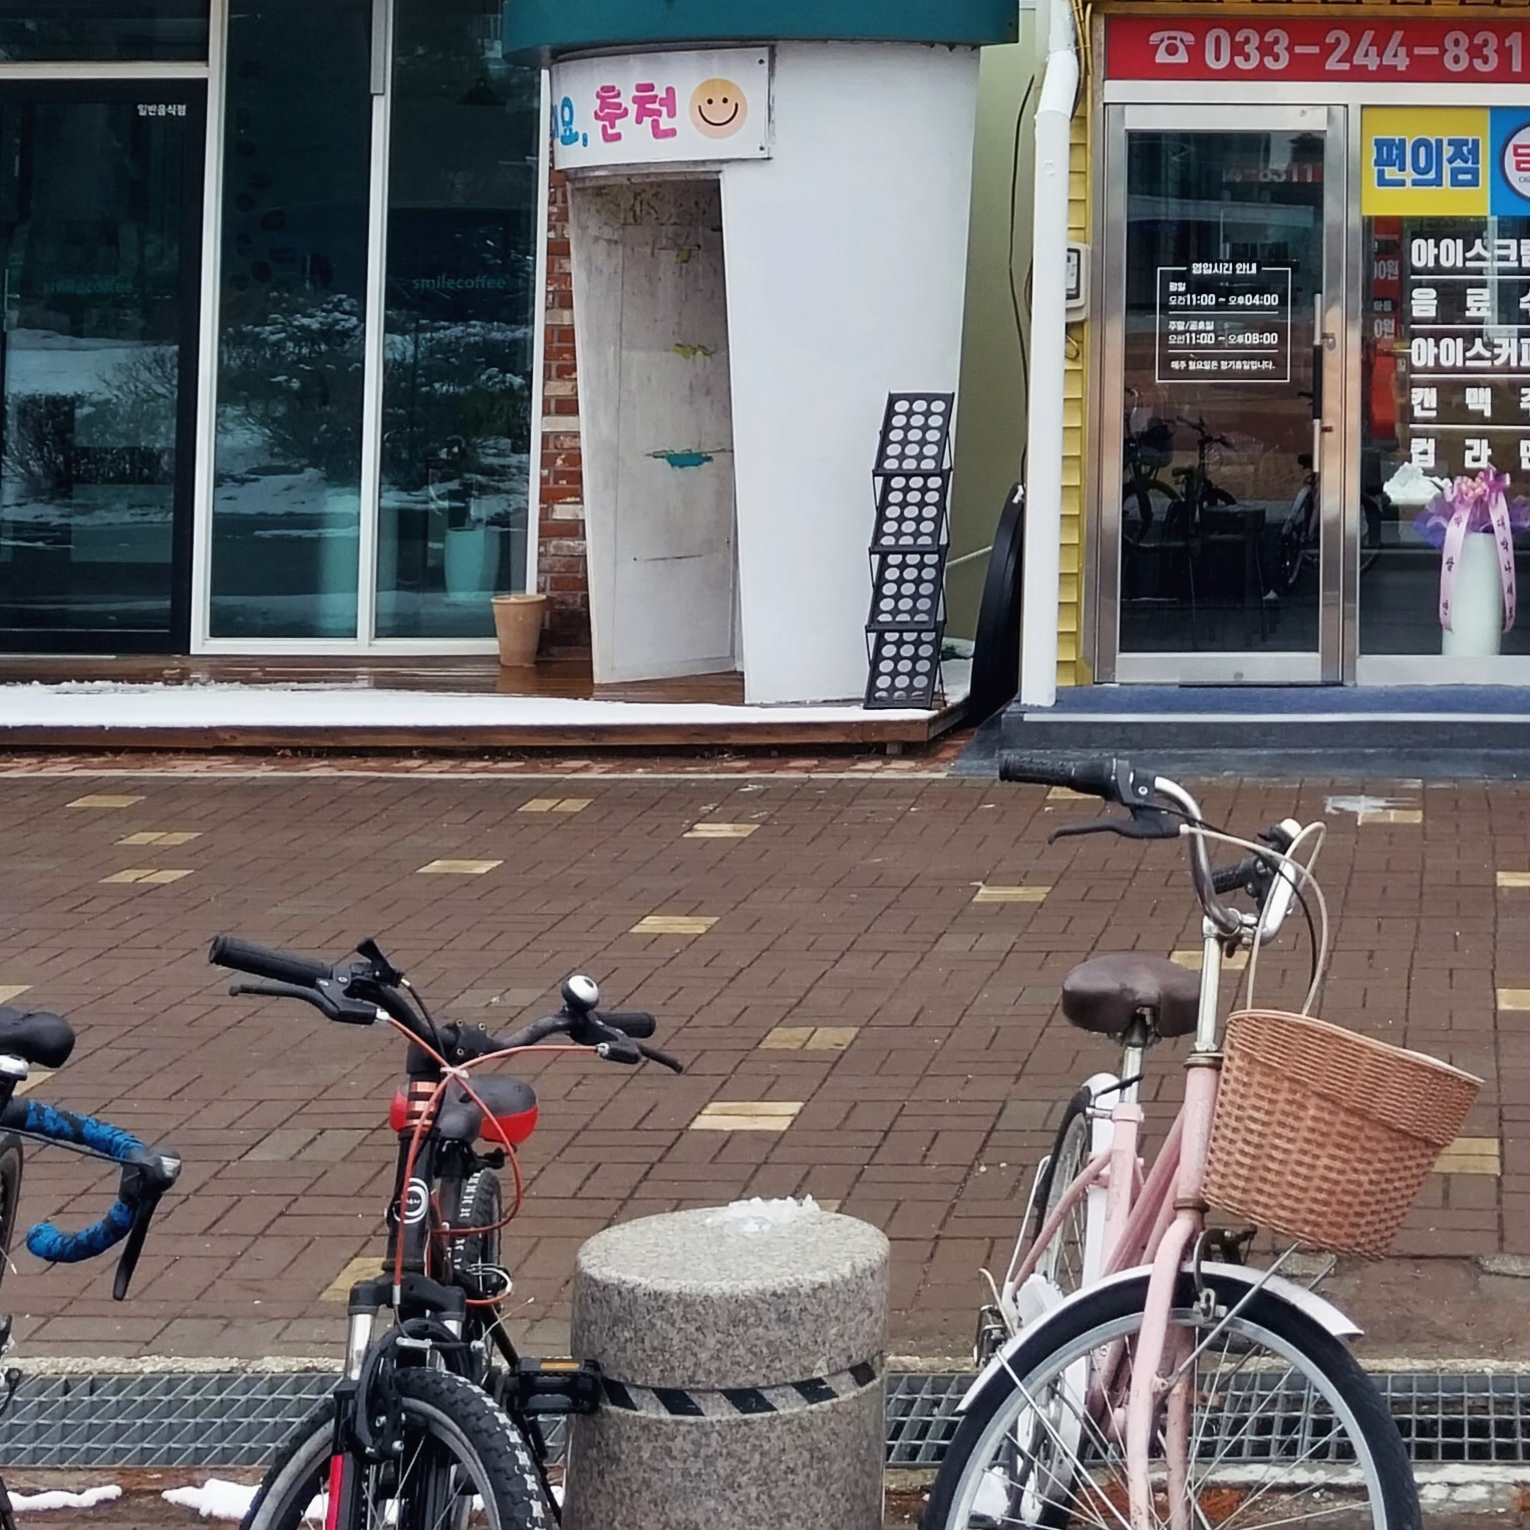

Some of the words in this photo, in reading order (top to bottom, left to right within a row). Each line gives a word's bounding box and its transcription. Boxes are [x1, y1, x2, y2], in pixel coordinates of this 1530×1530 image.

[137, 104, 186, 116] 일반음식점
[593, 82, 678, 144] 춘천
[1372, 135, 1481, 189] 편의점
[412, 274, 507, 289] smilecoffee
